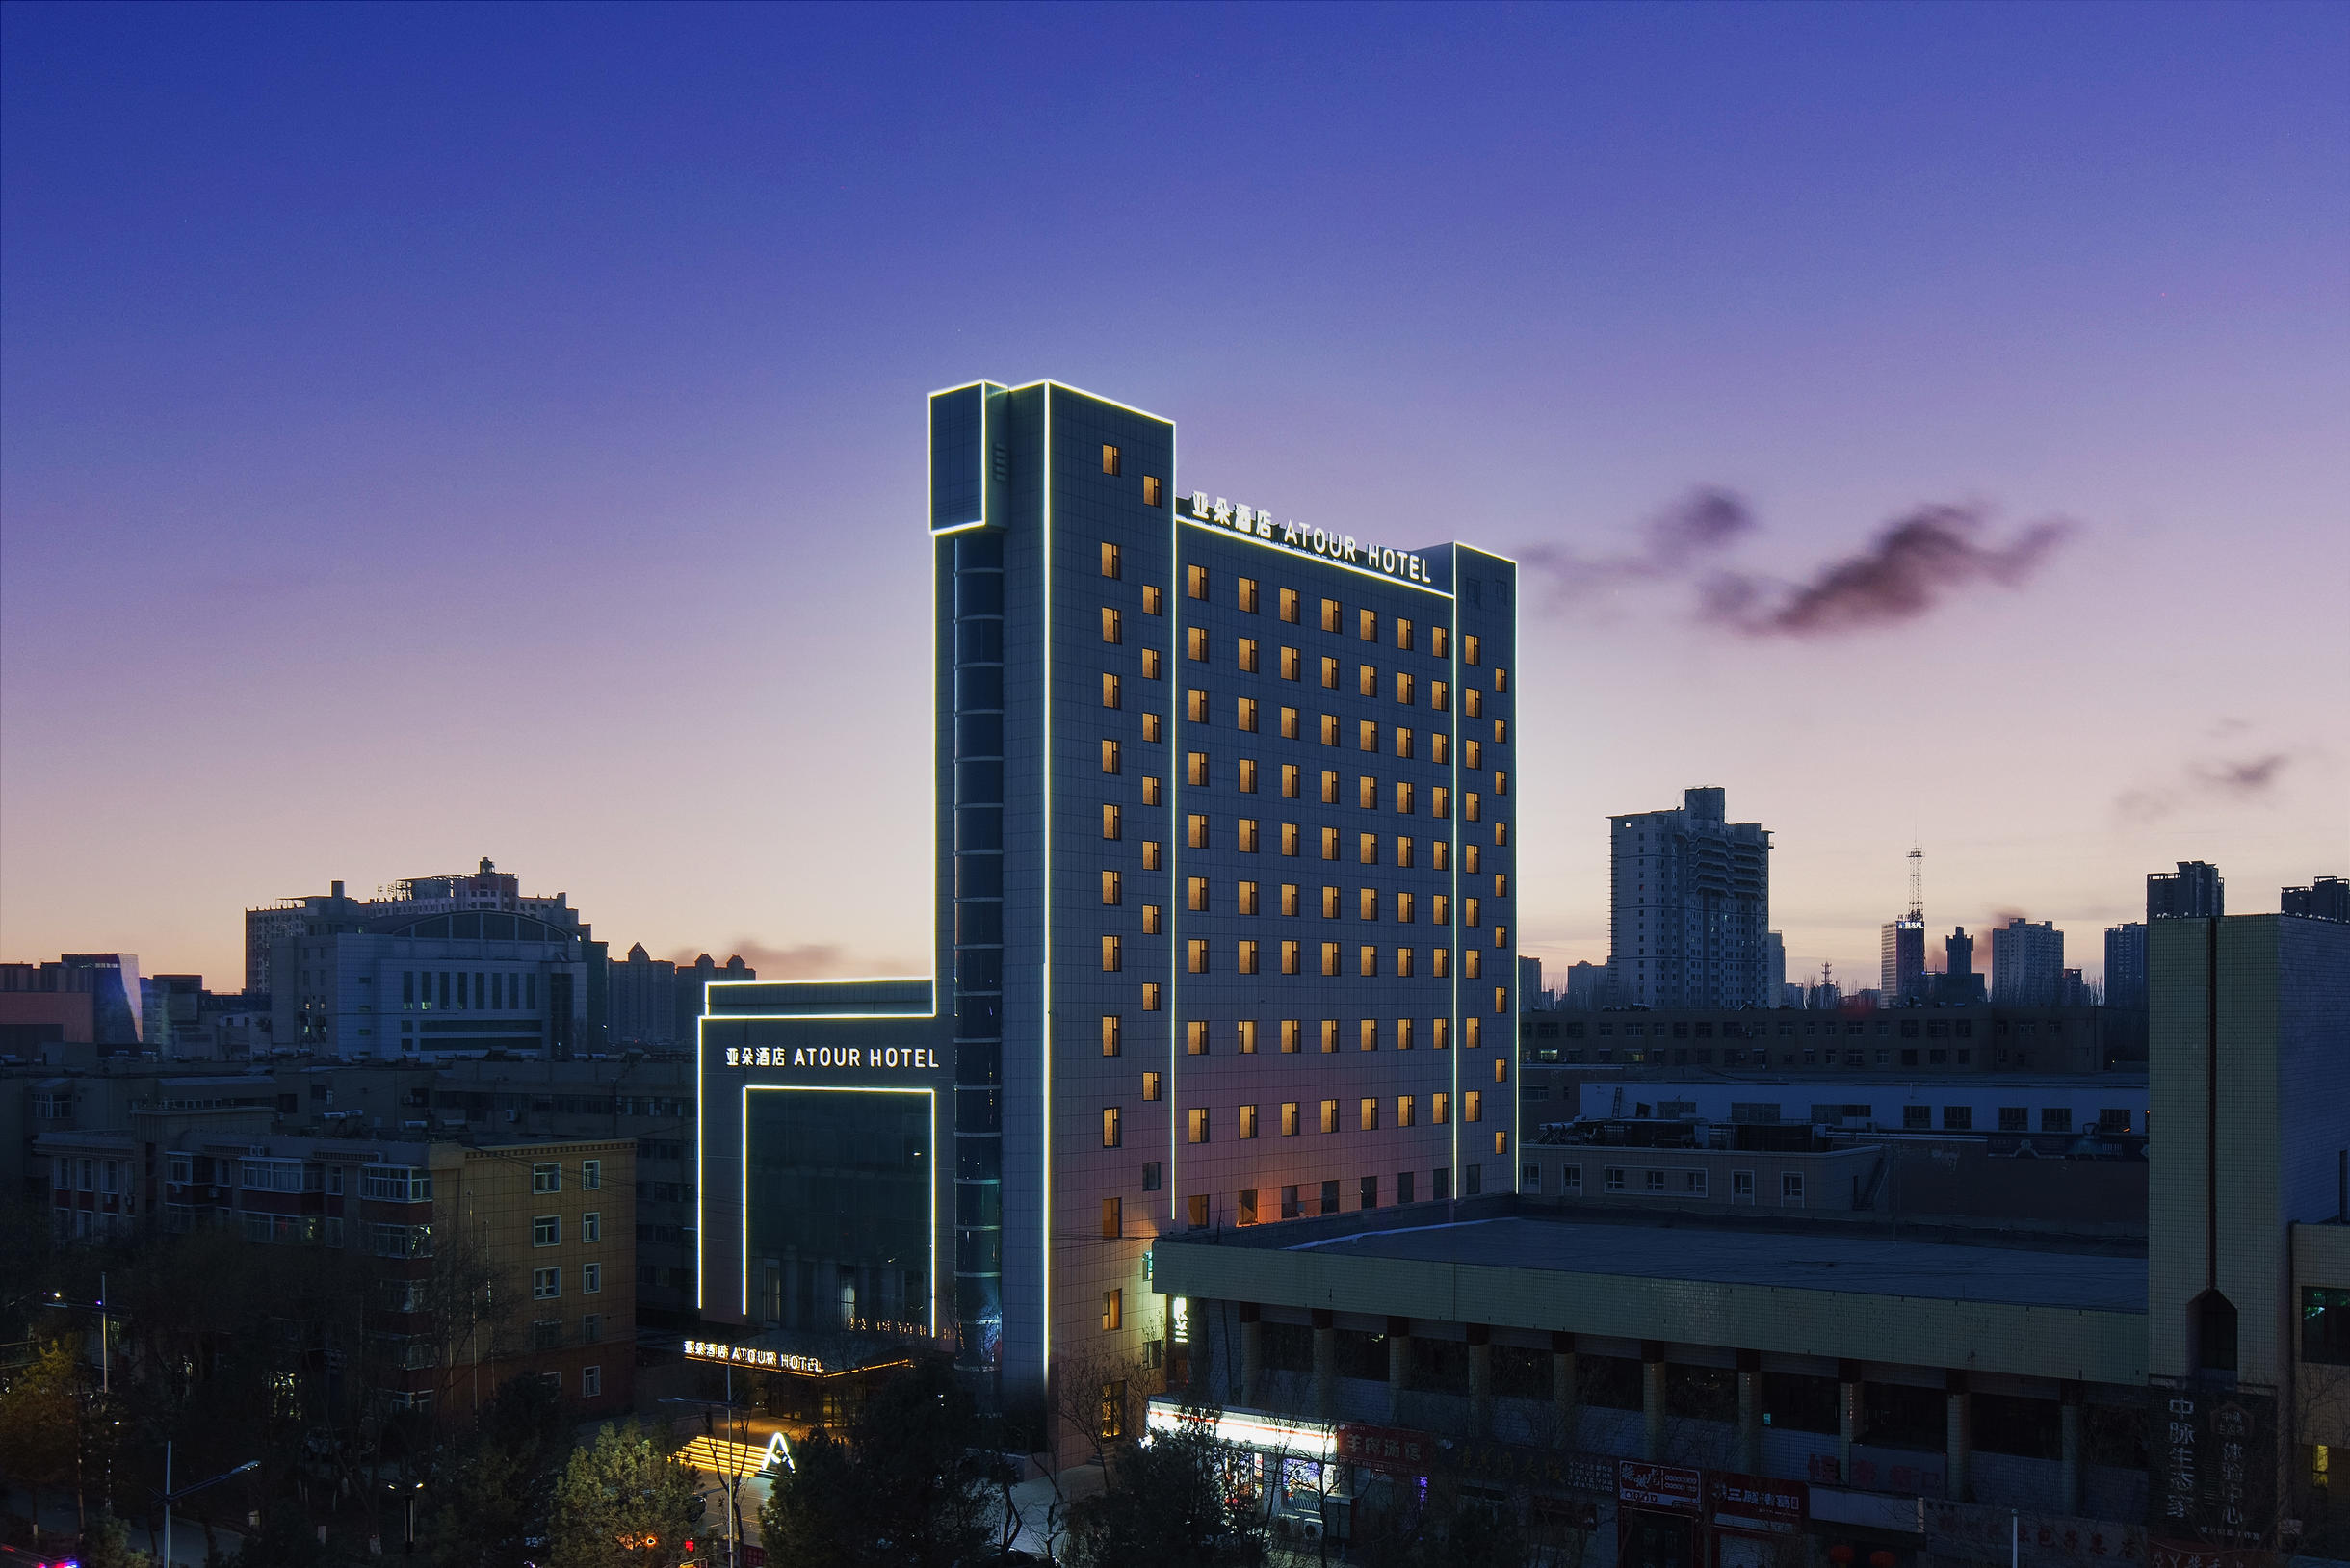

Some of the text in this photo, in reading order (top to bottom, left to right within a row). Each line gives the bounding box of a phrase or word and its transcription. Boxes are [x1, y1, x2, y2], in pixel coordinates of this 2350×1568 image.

[1191, 491, 1431, 583] 亚朵酒店 ATOUR HOTEL
[725, 1046, 940, 1068] 亚朵酒店 ATOUR HOTEL
[683, 1340, 824, 1372] 亚朵酒店 ATOUR HOTEL
